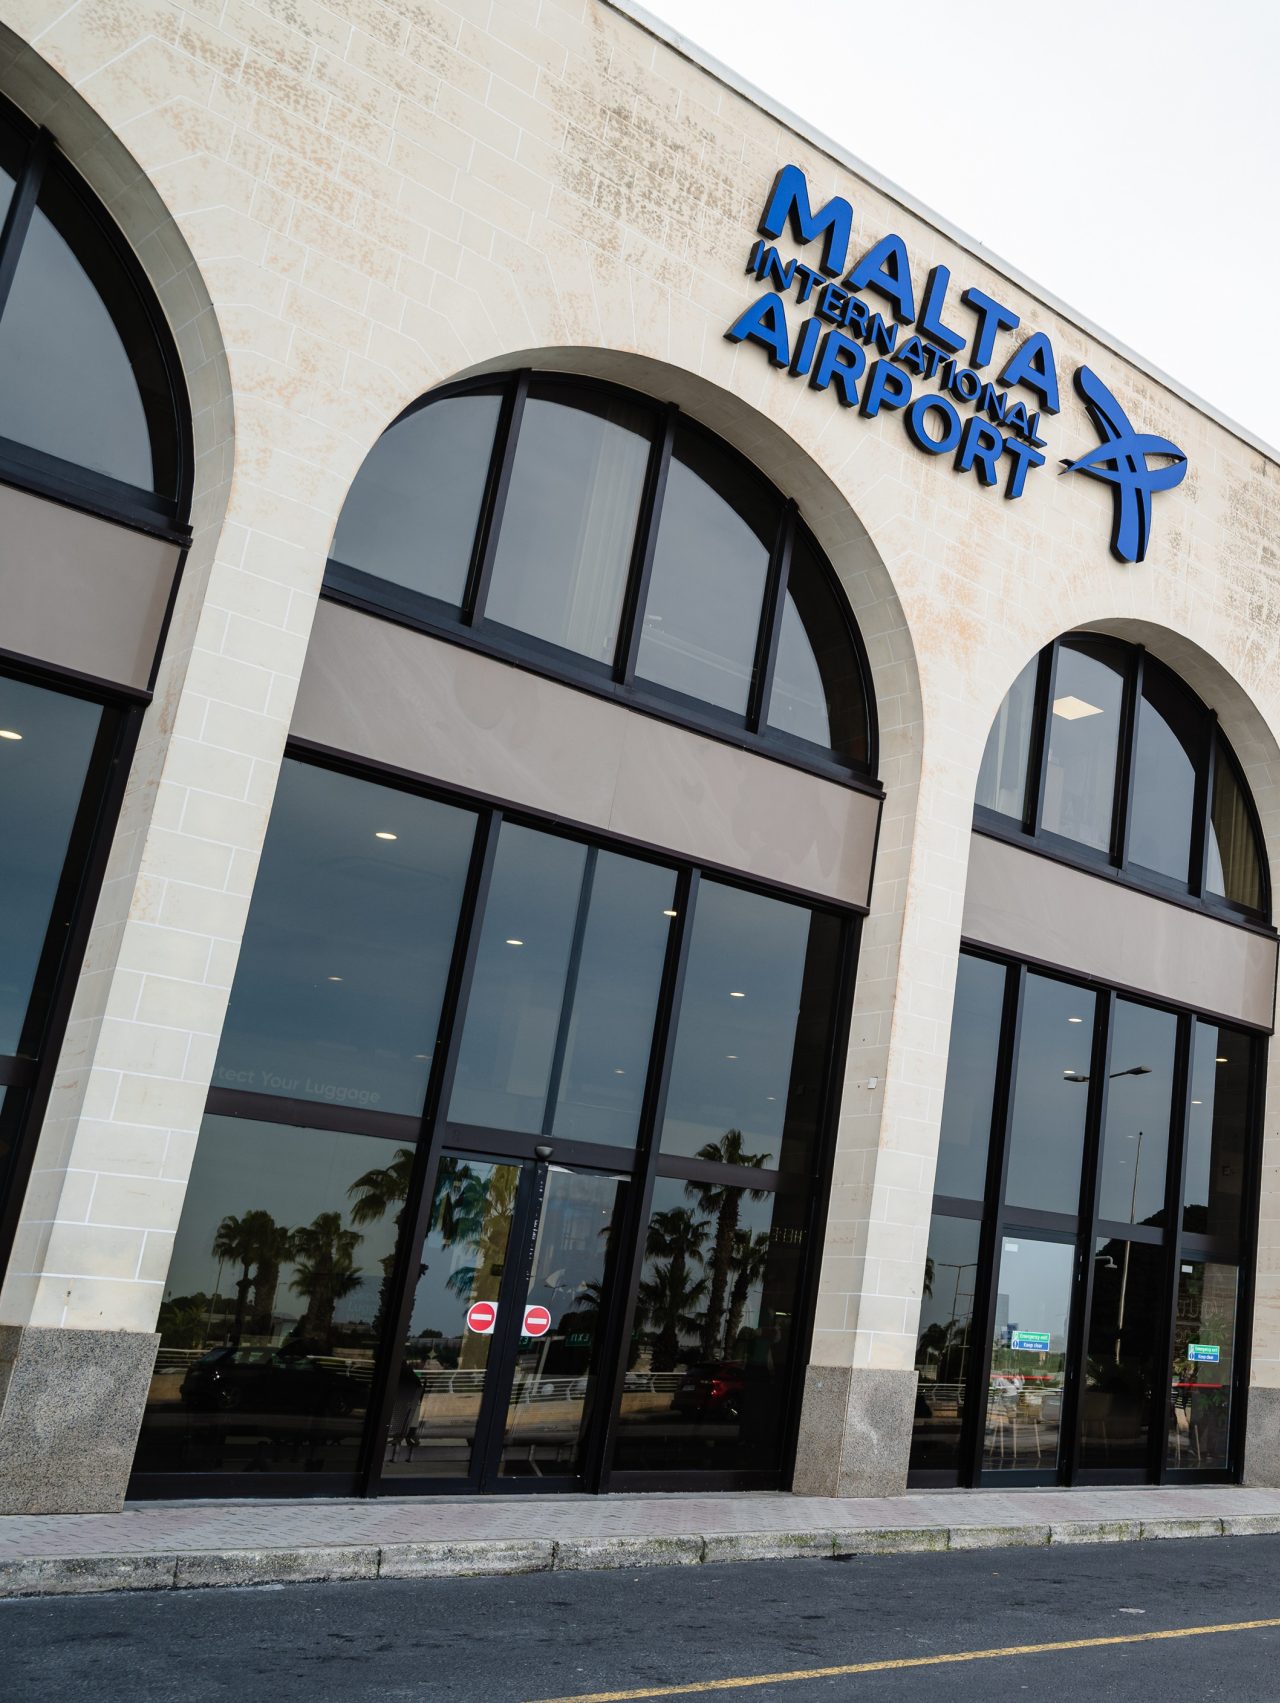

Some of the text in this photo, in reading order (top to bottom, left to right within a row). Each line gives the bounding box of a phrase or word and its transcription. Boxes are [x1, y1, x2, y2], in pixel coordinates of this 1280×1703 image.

[745, 239, 1048, 448] INTERNATIONAL
[757, 164, 1060, 415] MALTA
[723, 292, 1046, 500] AIRPORT
[262, 1071, 300, 1090] Your
[305, 1078, 380, 1104] Luggage
